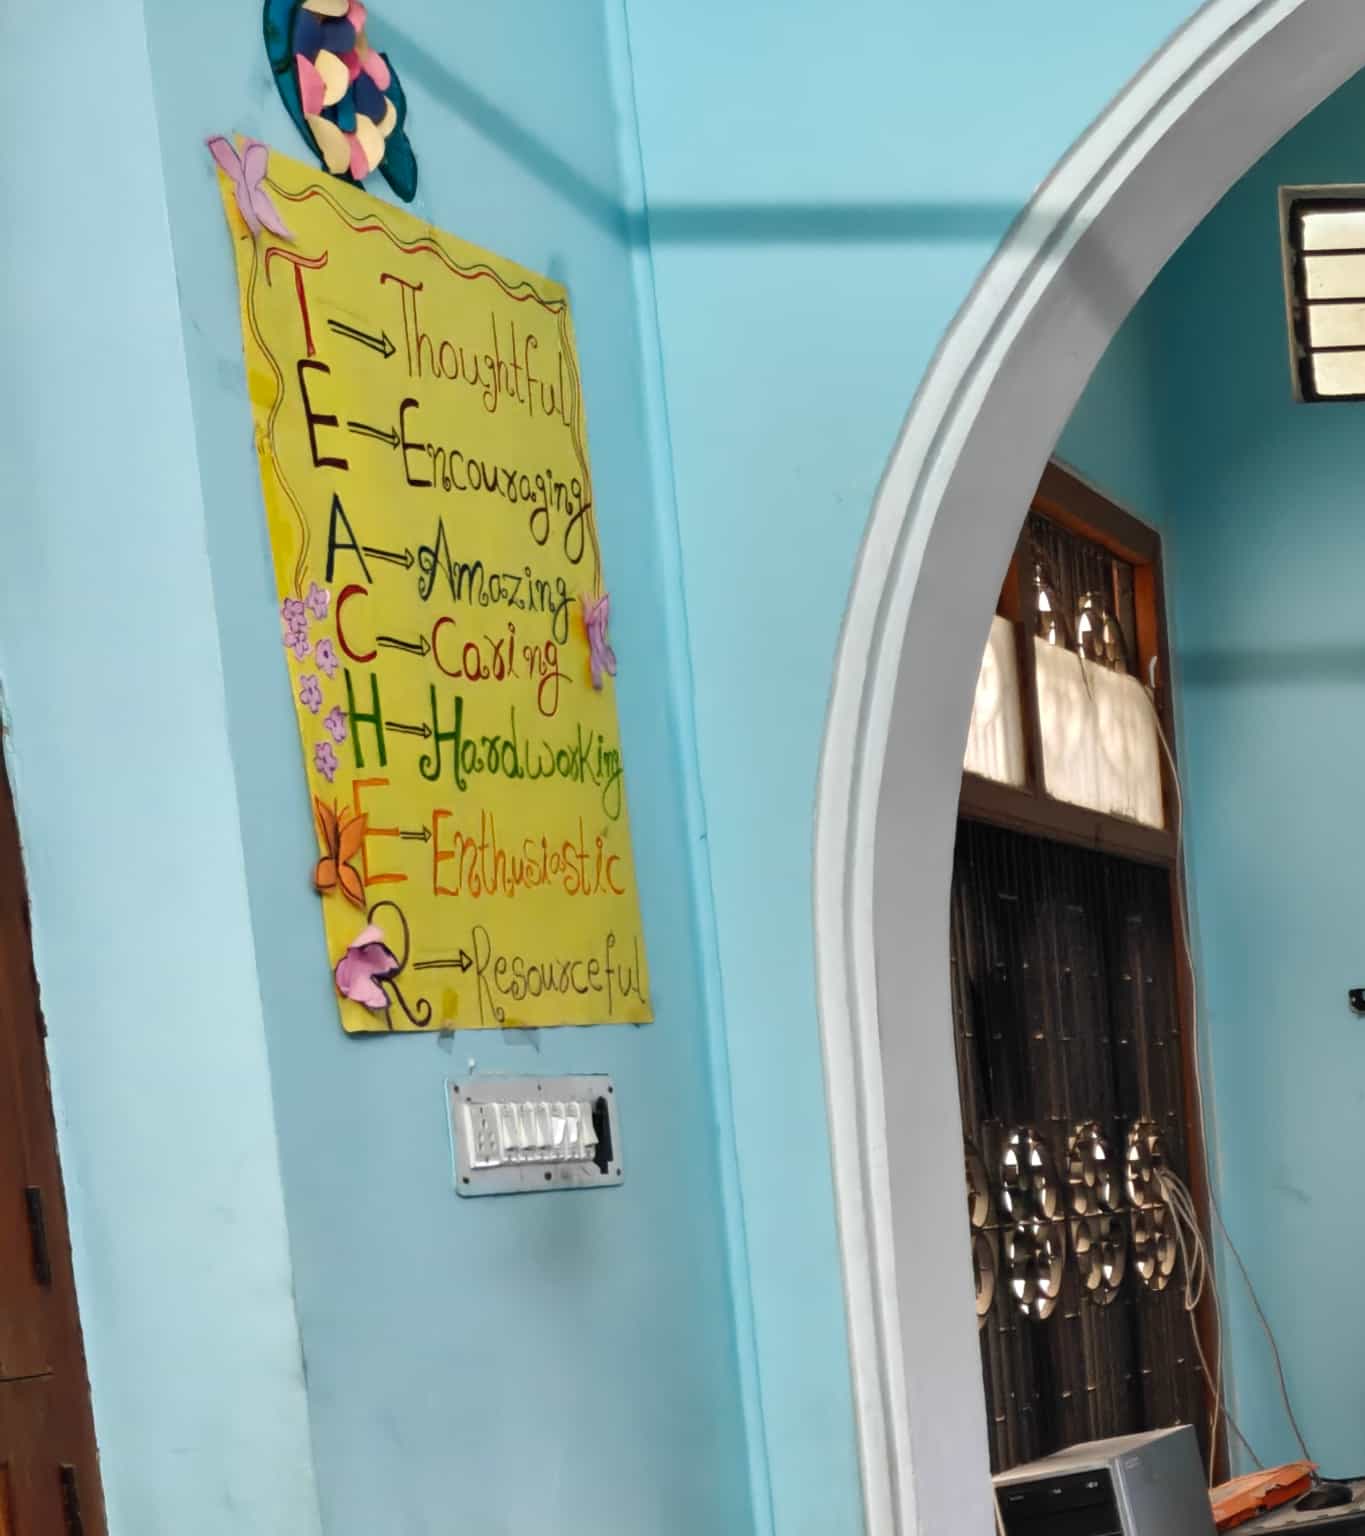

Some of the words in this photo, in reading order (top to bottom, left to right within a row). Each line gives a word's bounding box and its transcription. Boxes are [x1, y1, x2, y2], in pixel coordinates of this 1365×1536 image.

[381, 273, 571, 425] Thoughtful
[297, 359, 349, 471] E
[399, 398, 592, 564] Encouraging
[325, 492, 373, 584] A
[418, 516, 575, 645] Amazing
[336, 584, 378, 662] C
[432, 617, 573, 716] Caring
[343, 669, 387, 768] H
[419, 684, 623, 820] Hardworking
[432, 809, 627, 897] Enthusiastic
[472, 925, 645, 1025] Resourceful
